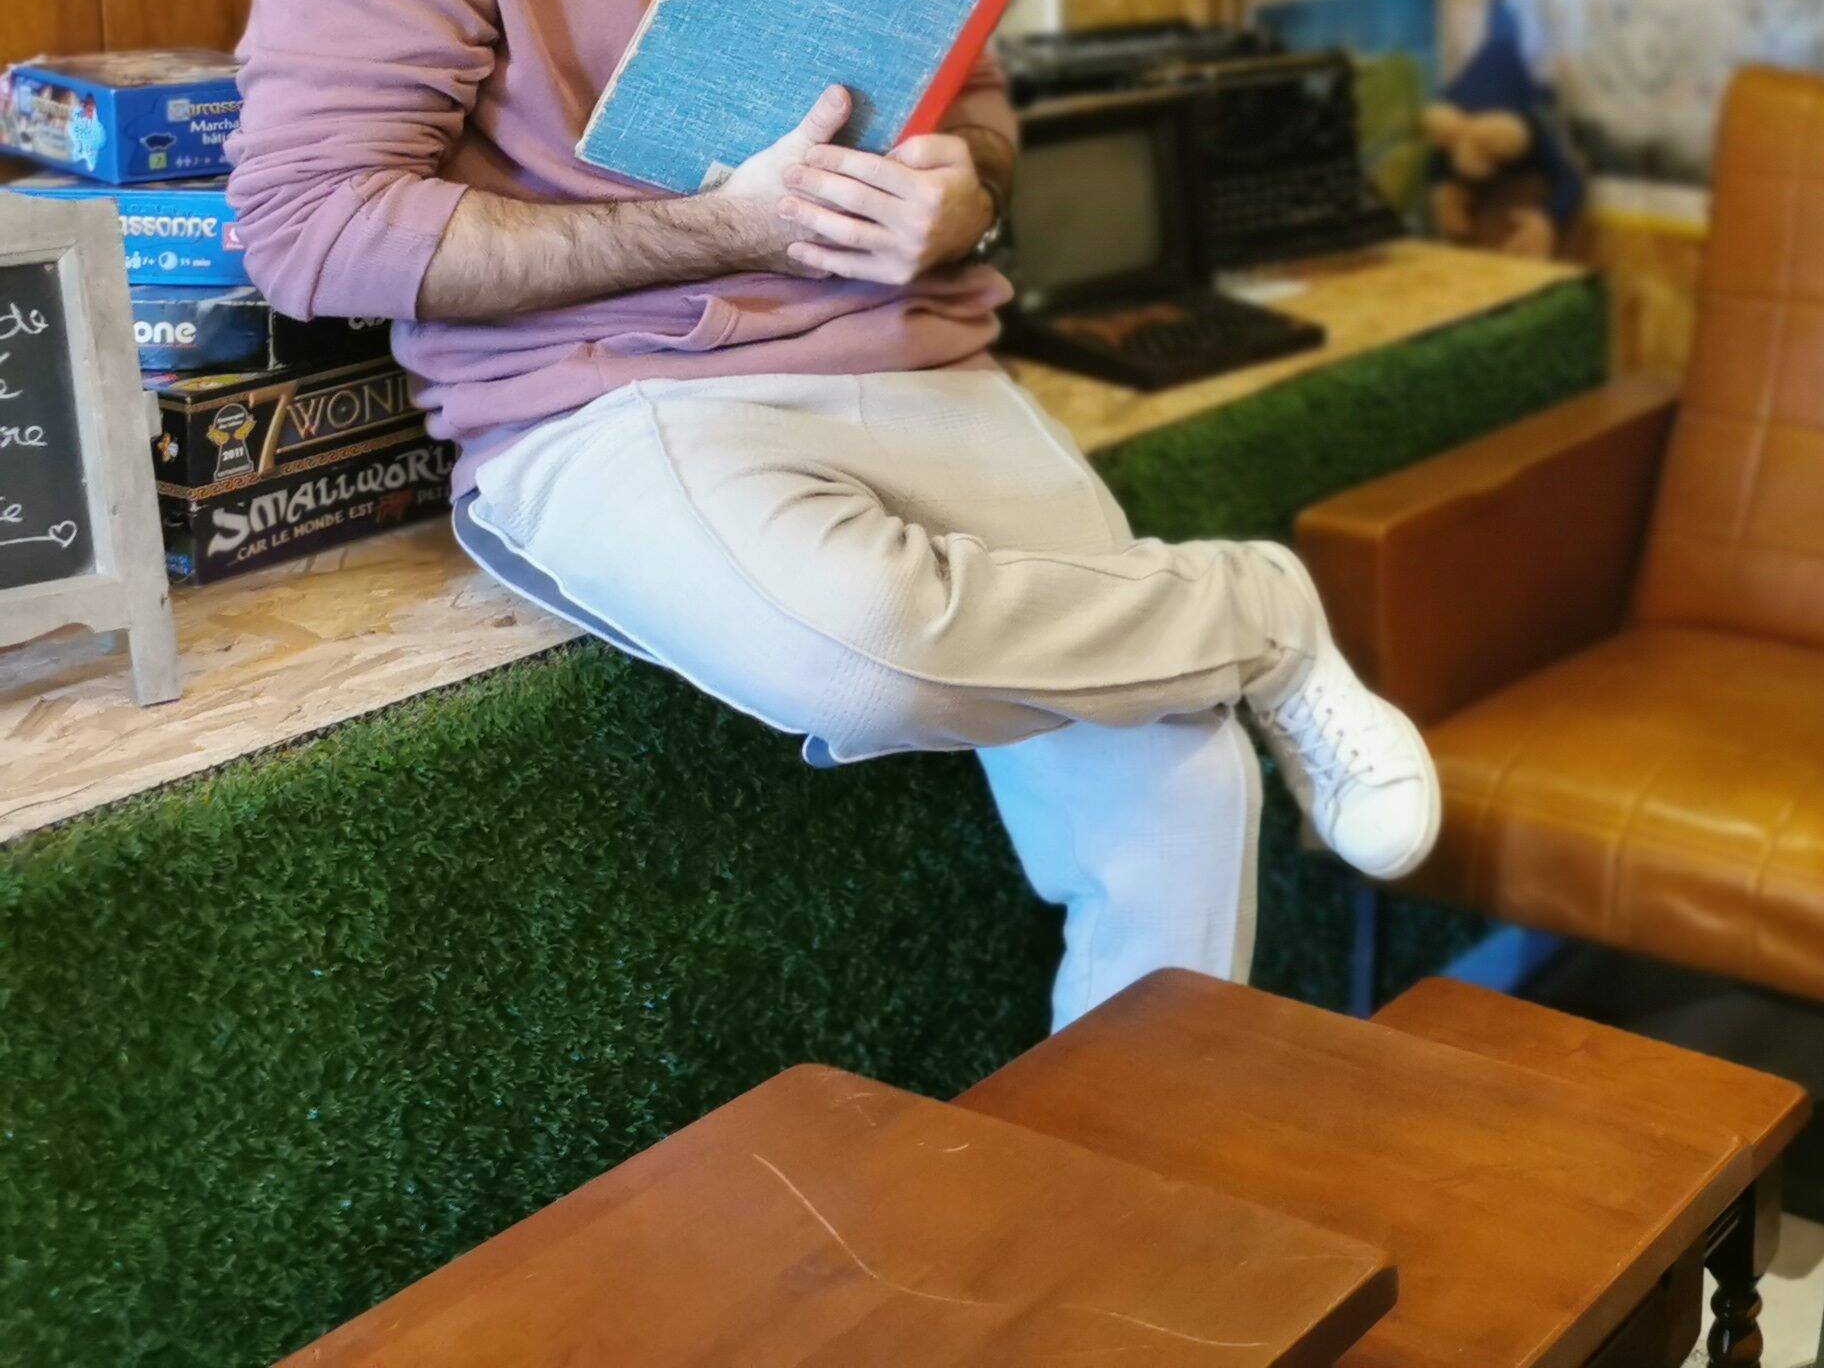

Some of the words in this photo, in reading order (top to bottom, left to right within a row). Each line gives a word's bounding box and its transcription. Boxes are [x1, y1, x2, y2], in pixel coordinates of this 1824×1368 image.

[251, 380, 298, 477] 7
[285, 374, 406, 439] WON
[222, 447, 246, 462] 2011
[271, 531, 290, 549] LE
[293, 512, 346, 541] MONDE
[349, 499, 375, 519] EST
